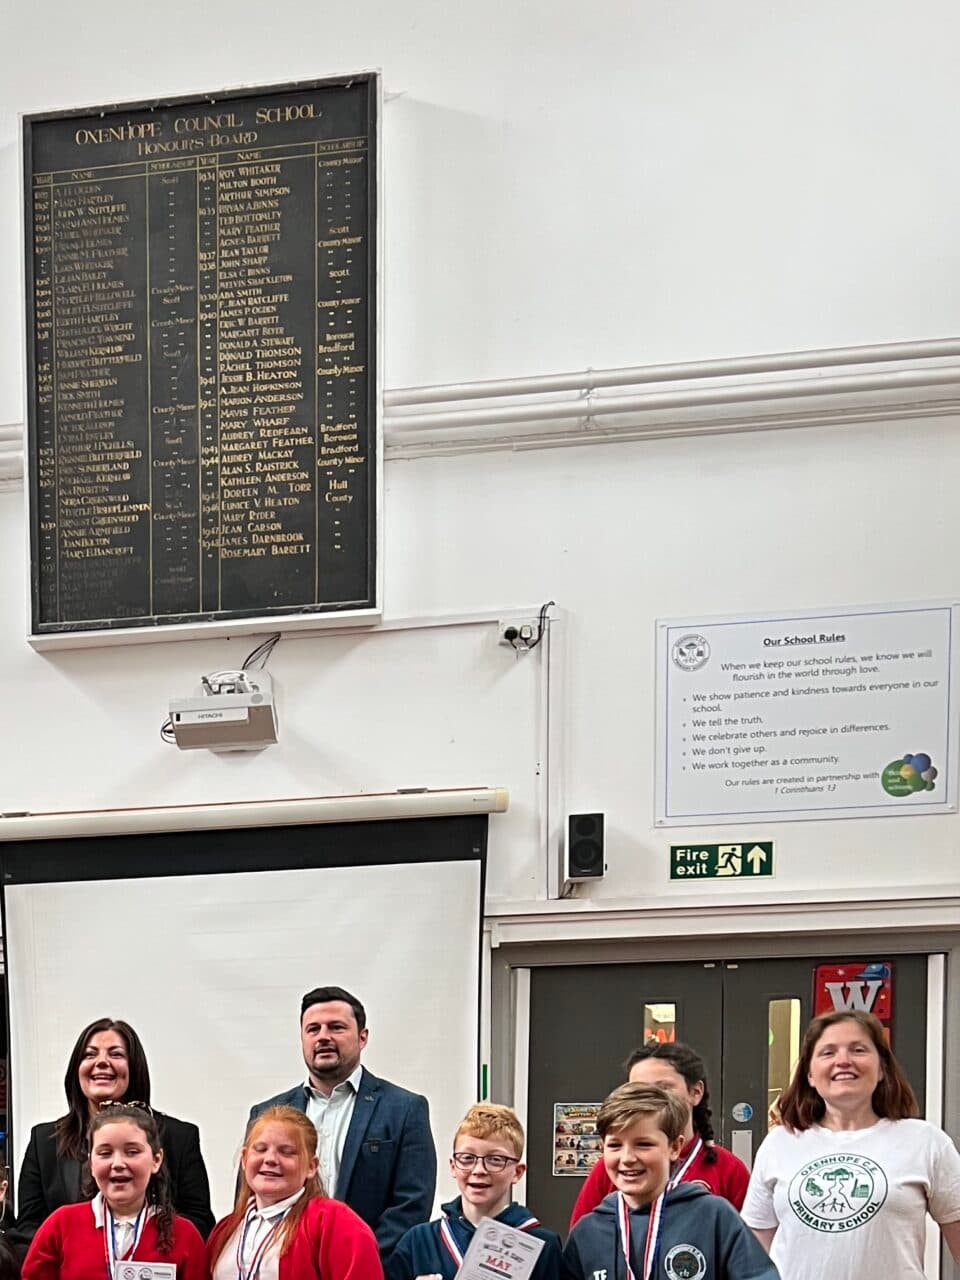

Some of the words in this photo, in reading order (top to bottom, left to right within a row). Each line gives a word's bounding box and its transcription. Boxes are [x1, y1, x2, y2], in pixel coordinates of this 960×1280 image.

[76, 122, 161, 145] OXENHOPE
[175, 114, 243, 133] COUNCIL
[256, 104, 322, 124] SCHOOL
[211, 132, 257, 147] BOARD
[763, 637, 782, 647] Our
[784, 635, 816, 646] School
[819, 633, 846, 643] Rules
[692, 693, 707, 701] We
[709, 693, 731, 701] show
[734, 690, 770, 701] patience
[772, 689, 789, 697] and
[791, 687, 829, 696] kindness
[832, 684, 866, 693] towards
[869, 682, 910, 692] everyone
[692, 719, 707, 728] We
[708, 718, 722, 727] tell
[725, 717, 738, 725] the
[676, 848, 709, 861] Fire
[676, 863, 708, 875] exit
[825, 980, 883, 1013] W
[801, 1156, 860, 1176] OXENHOPE
[793, 1200, 835, 1230] PRIMARY
[838, 1201, 880, 1230] SCHOOL
[485, 1255, 512, 1271] MAY
